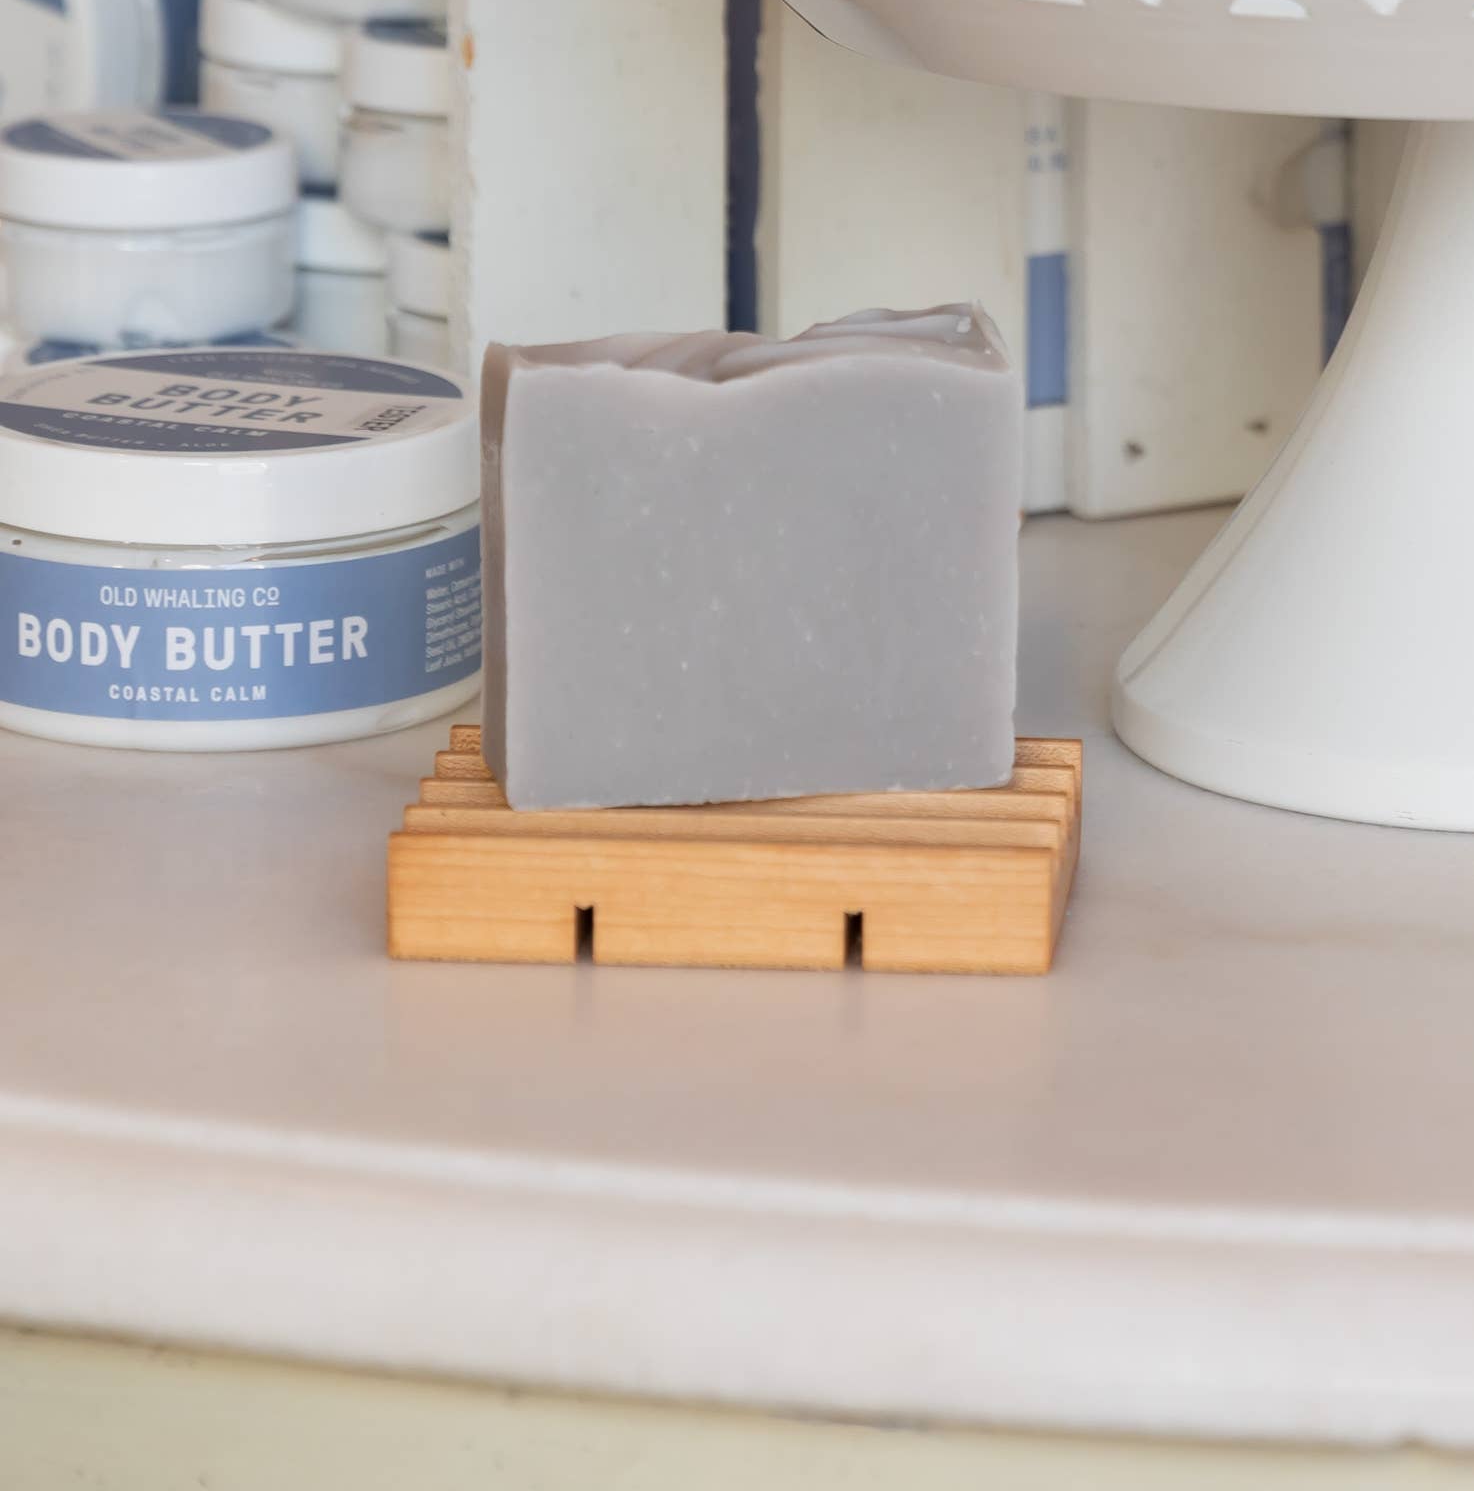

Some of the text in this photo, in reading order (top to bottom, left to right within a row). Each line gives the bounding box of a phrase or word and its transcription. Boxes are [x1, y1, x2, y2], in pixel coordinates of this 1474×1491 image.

[156, 383, 322, 407] BODY
[87, 393, 323, 423] BUTTER
[100, 586, 138, 607] OLD
[144, 588, 245, 609] WHALING
[19, 612, 368, 670] BODY BUTTER
[109, 684, 266, 702] COASTAL CALM
